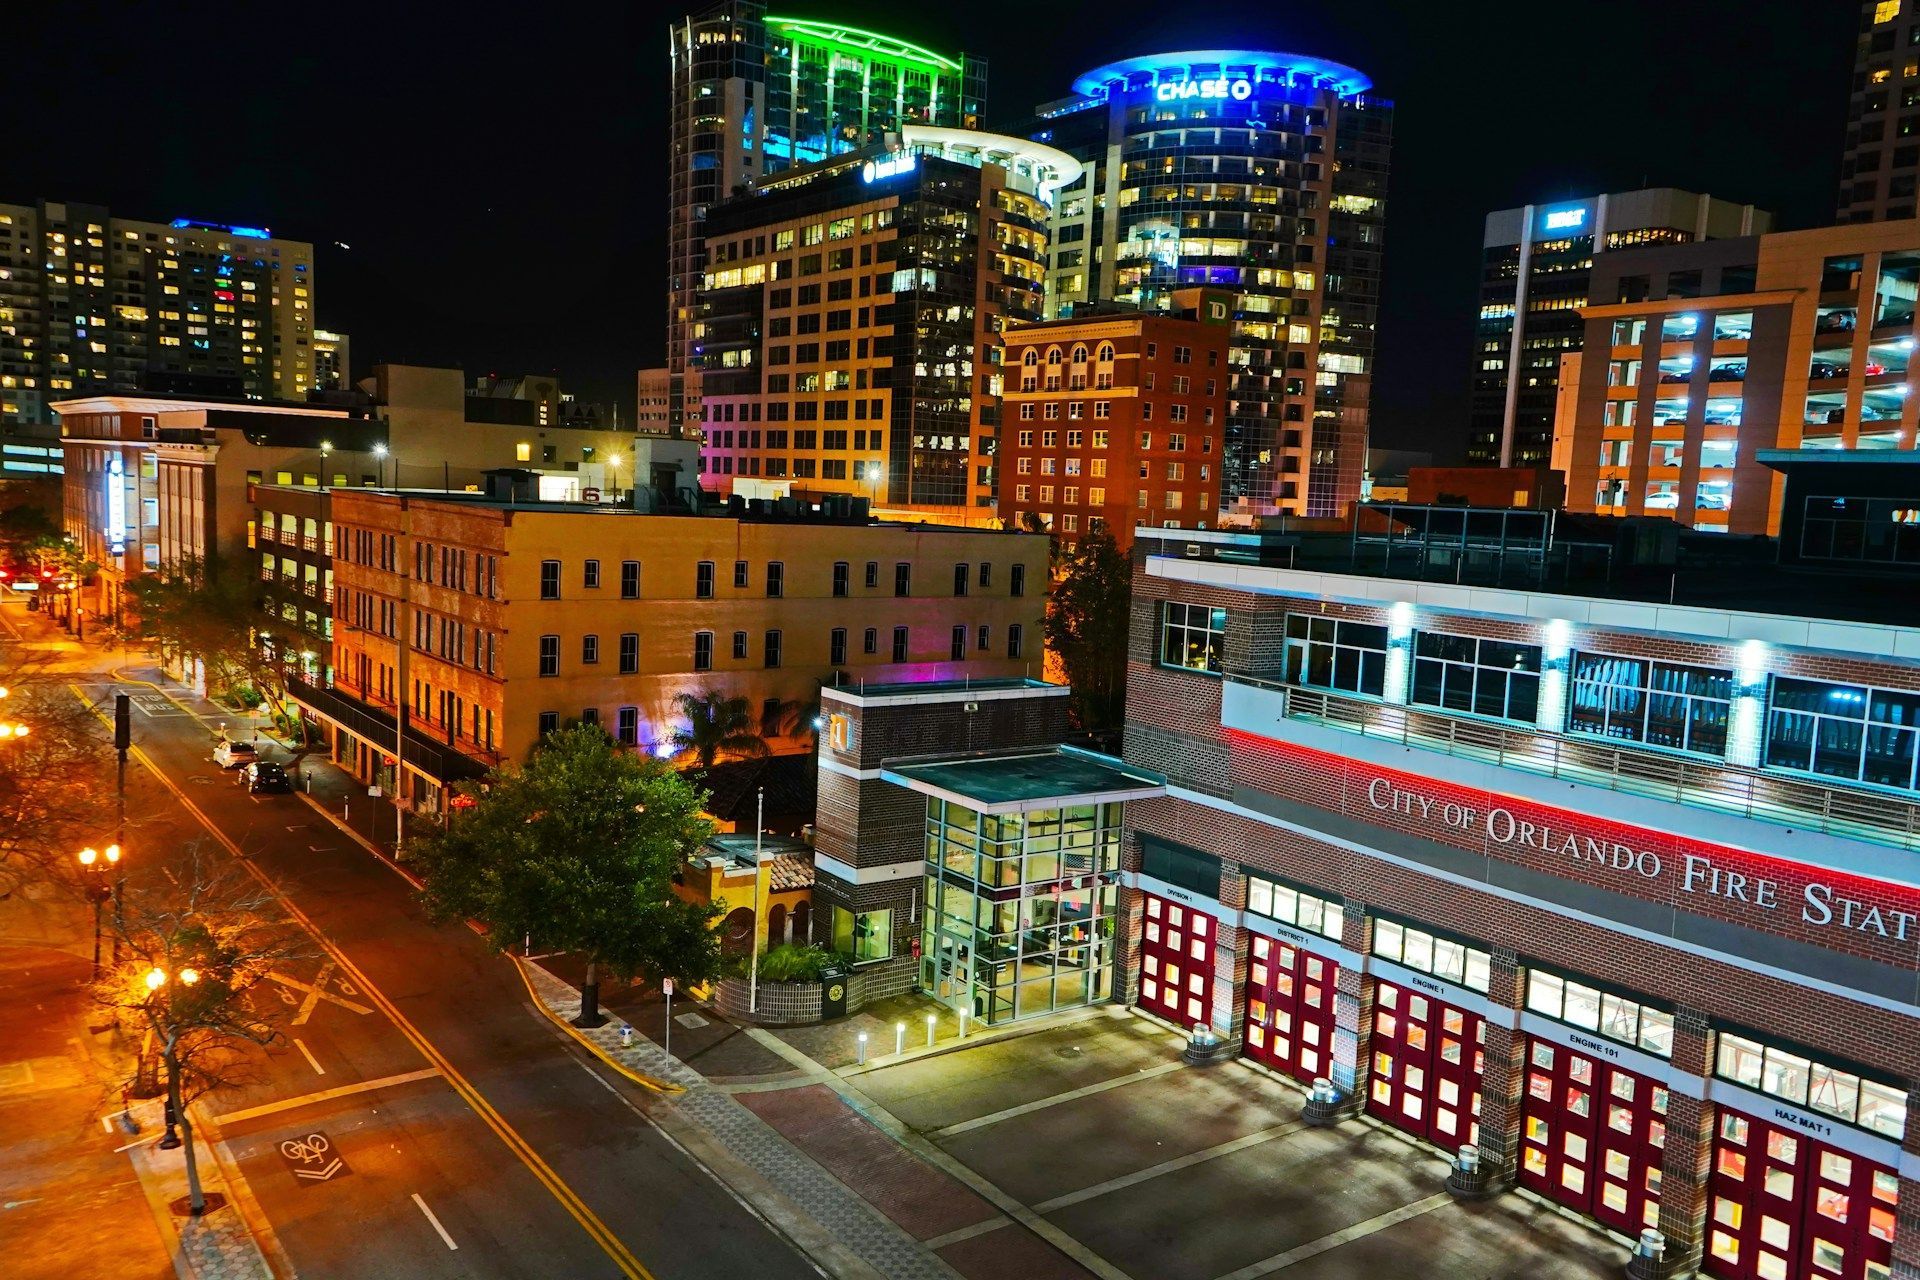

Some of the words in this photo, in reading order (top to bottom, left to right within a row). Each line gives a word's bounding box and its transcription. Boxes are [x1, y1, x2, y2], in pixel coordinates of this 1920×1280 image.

[1157, 80, 1229, 101] CHASE
[1209, 301, 1227, 319] TD
[1368, 777, 1436, 819] CITY
[1443, 804, 1477, 830] OF
[1486, 807, 1661, 878] ORLANDO
[1679, 853, 1778, 910] FIRE
[1167, 888, 1189, 901] DIVISION
[1277, 928, 1304, 943] DISTRICT
[1412, 977, 1439, 993] ENGINE
[1570, 1034, 1603, 1053] ENGINE
[1605, 1047, 1619, 1058] 101
[1775, 1109, 1797, 1124] HAZ
[1799, 1117, 1823, 1133] MAT
